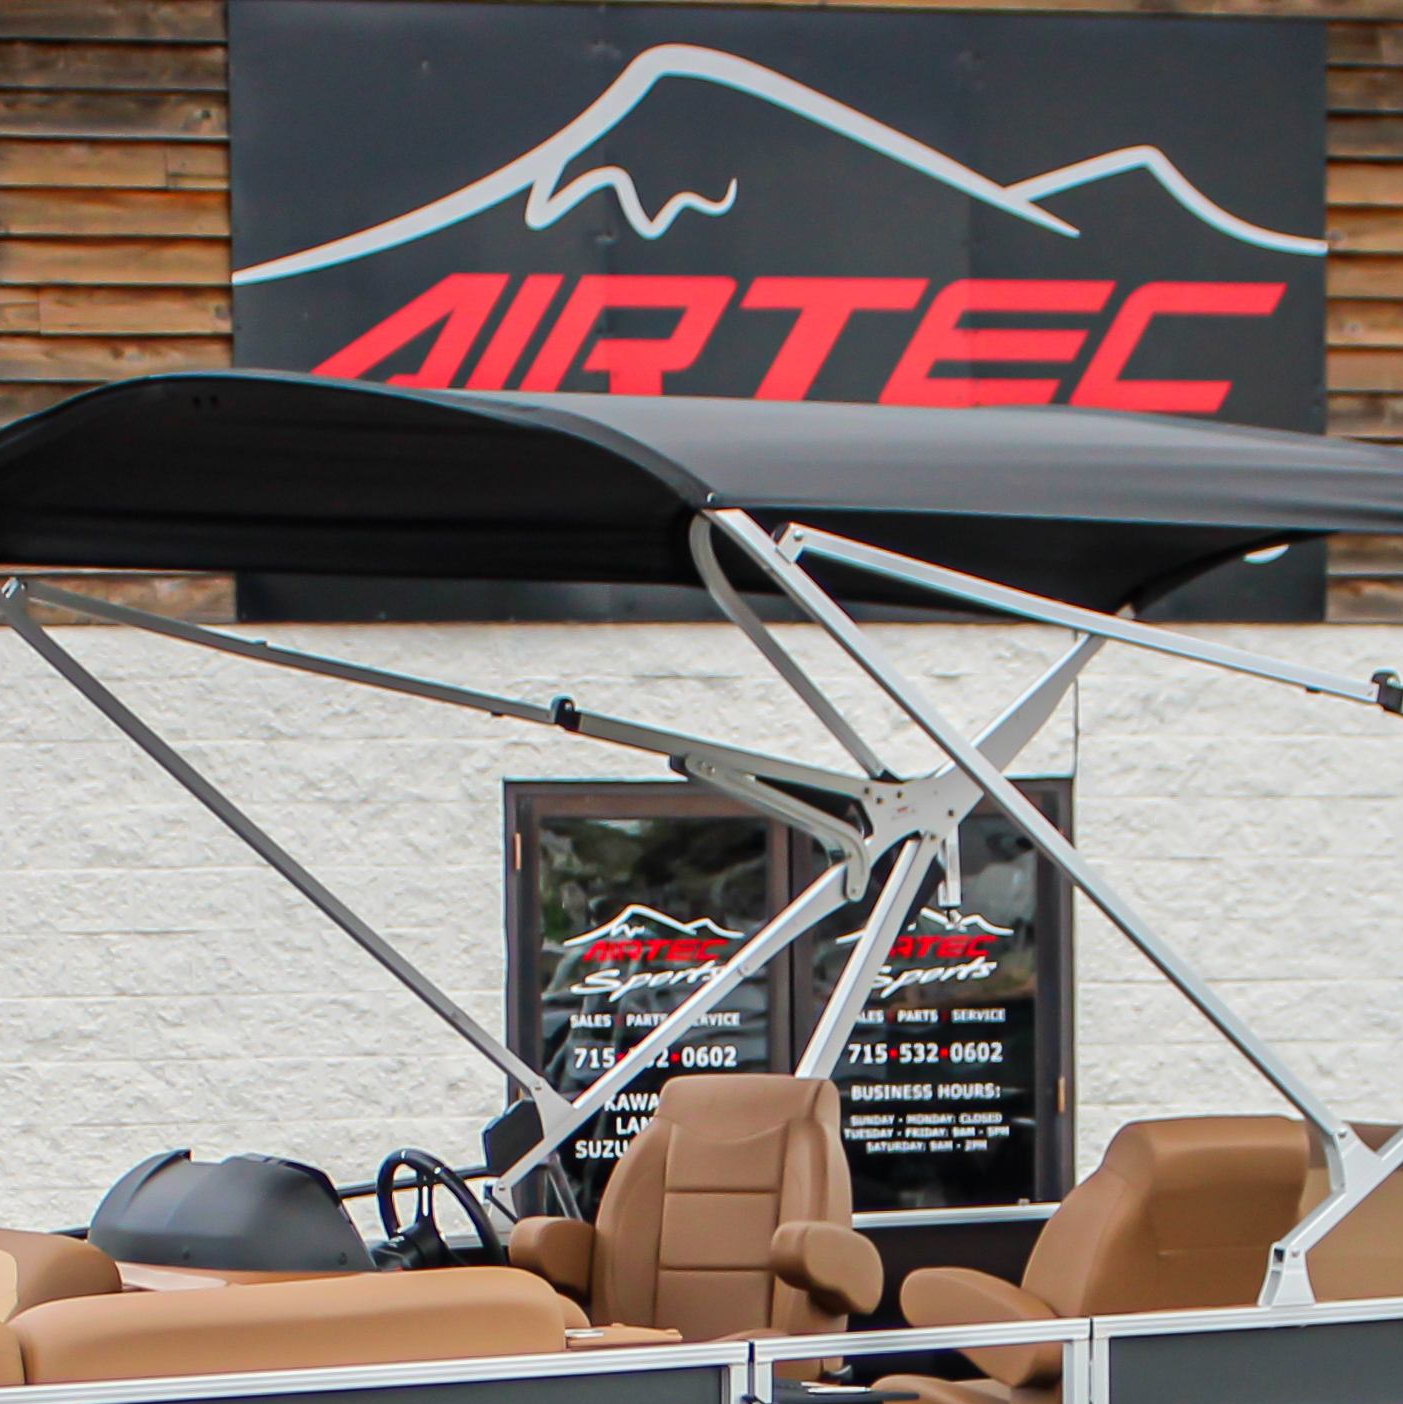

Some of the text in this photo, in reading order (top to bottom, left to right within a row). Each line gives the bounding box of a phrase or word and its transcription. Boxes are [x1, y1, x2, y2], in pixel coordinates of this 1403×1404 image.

[309, 272, 1288, 413] AIRTEC
[582, 938, 729, 962] AIRTEC
[889, 935, 999, 959] RTEC
[570, 1012, 612, 1028] SALES
[897, 1008, 939, 1023] PARTS
[951, 1007, 1006, 1023] SERVICE
[851, 1083, 1001, 1101] BUSINESS HOURS:
[604, 1093, 660, 1111] KAWA
[575, 1139, 630, 1158] SUZU
